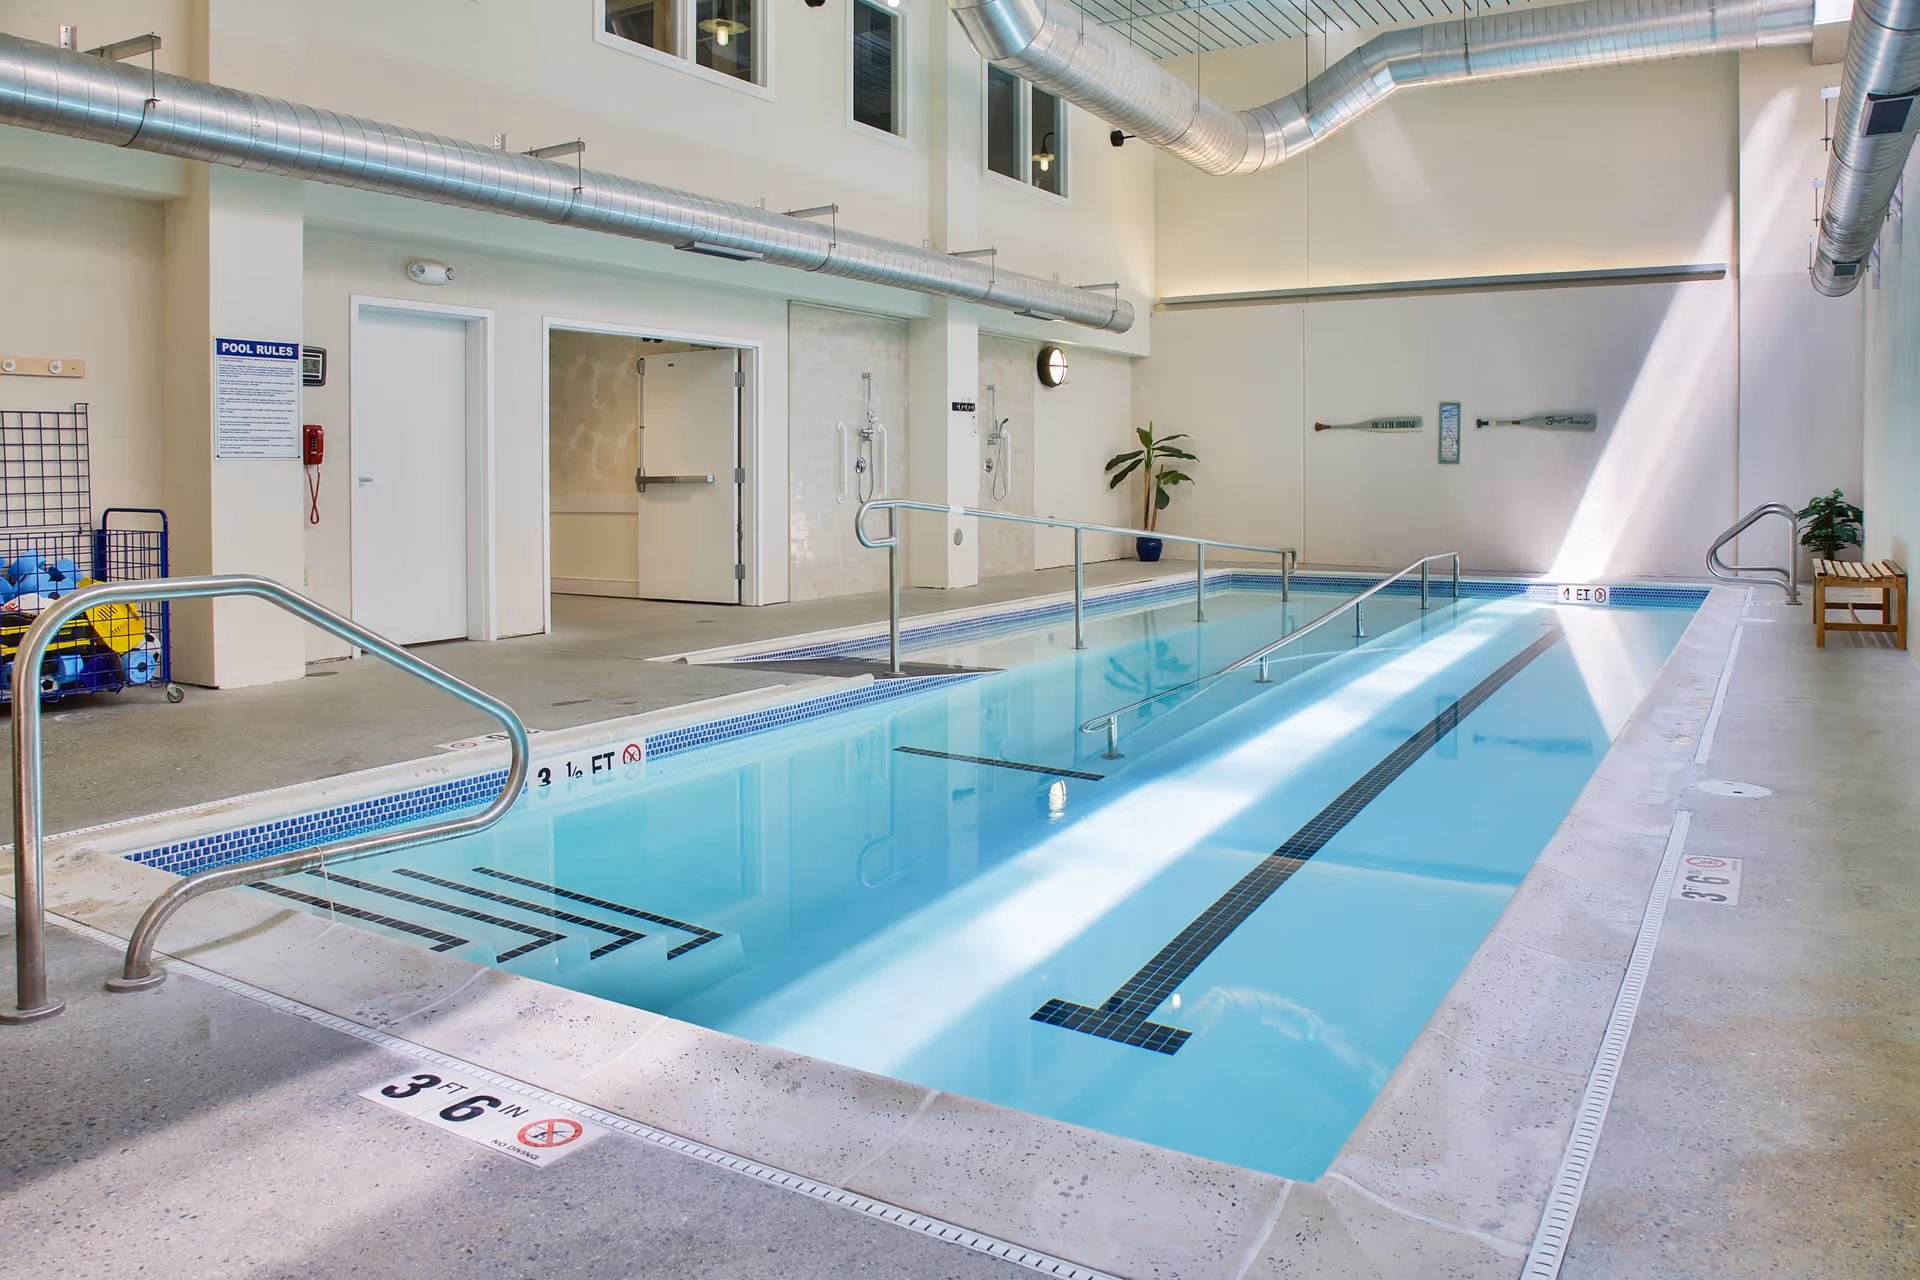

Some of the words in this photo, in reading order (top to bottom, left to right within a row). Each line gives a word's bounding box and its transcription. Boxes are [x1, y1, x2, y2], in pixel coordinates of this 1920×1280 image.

[222, 342, 253, 353] POOL
[256, 345, 293, 356] RULES
[1371, 421, 1394, 429] BEACH
[537, 767, 552, 787] 3
[592, 751, 615, 774] FT
[1685, 875, 1730, 885] 6
[1681, 891, 1727, 902] 3
[381, 1074, 442, 1098] 3
[437, 1081, 469, 1095] FT
[439, 1095, 502, 1122] 6
[498, 1104, 529, 1118] IN
[491, 1139, 507, 1147] NO
[506, 1145, 540, 1160] DIVING
